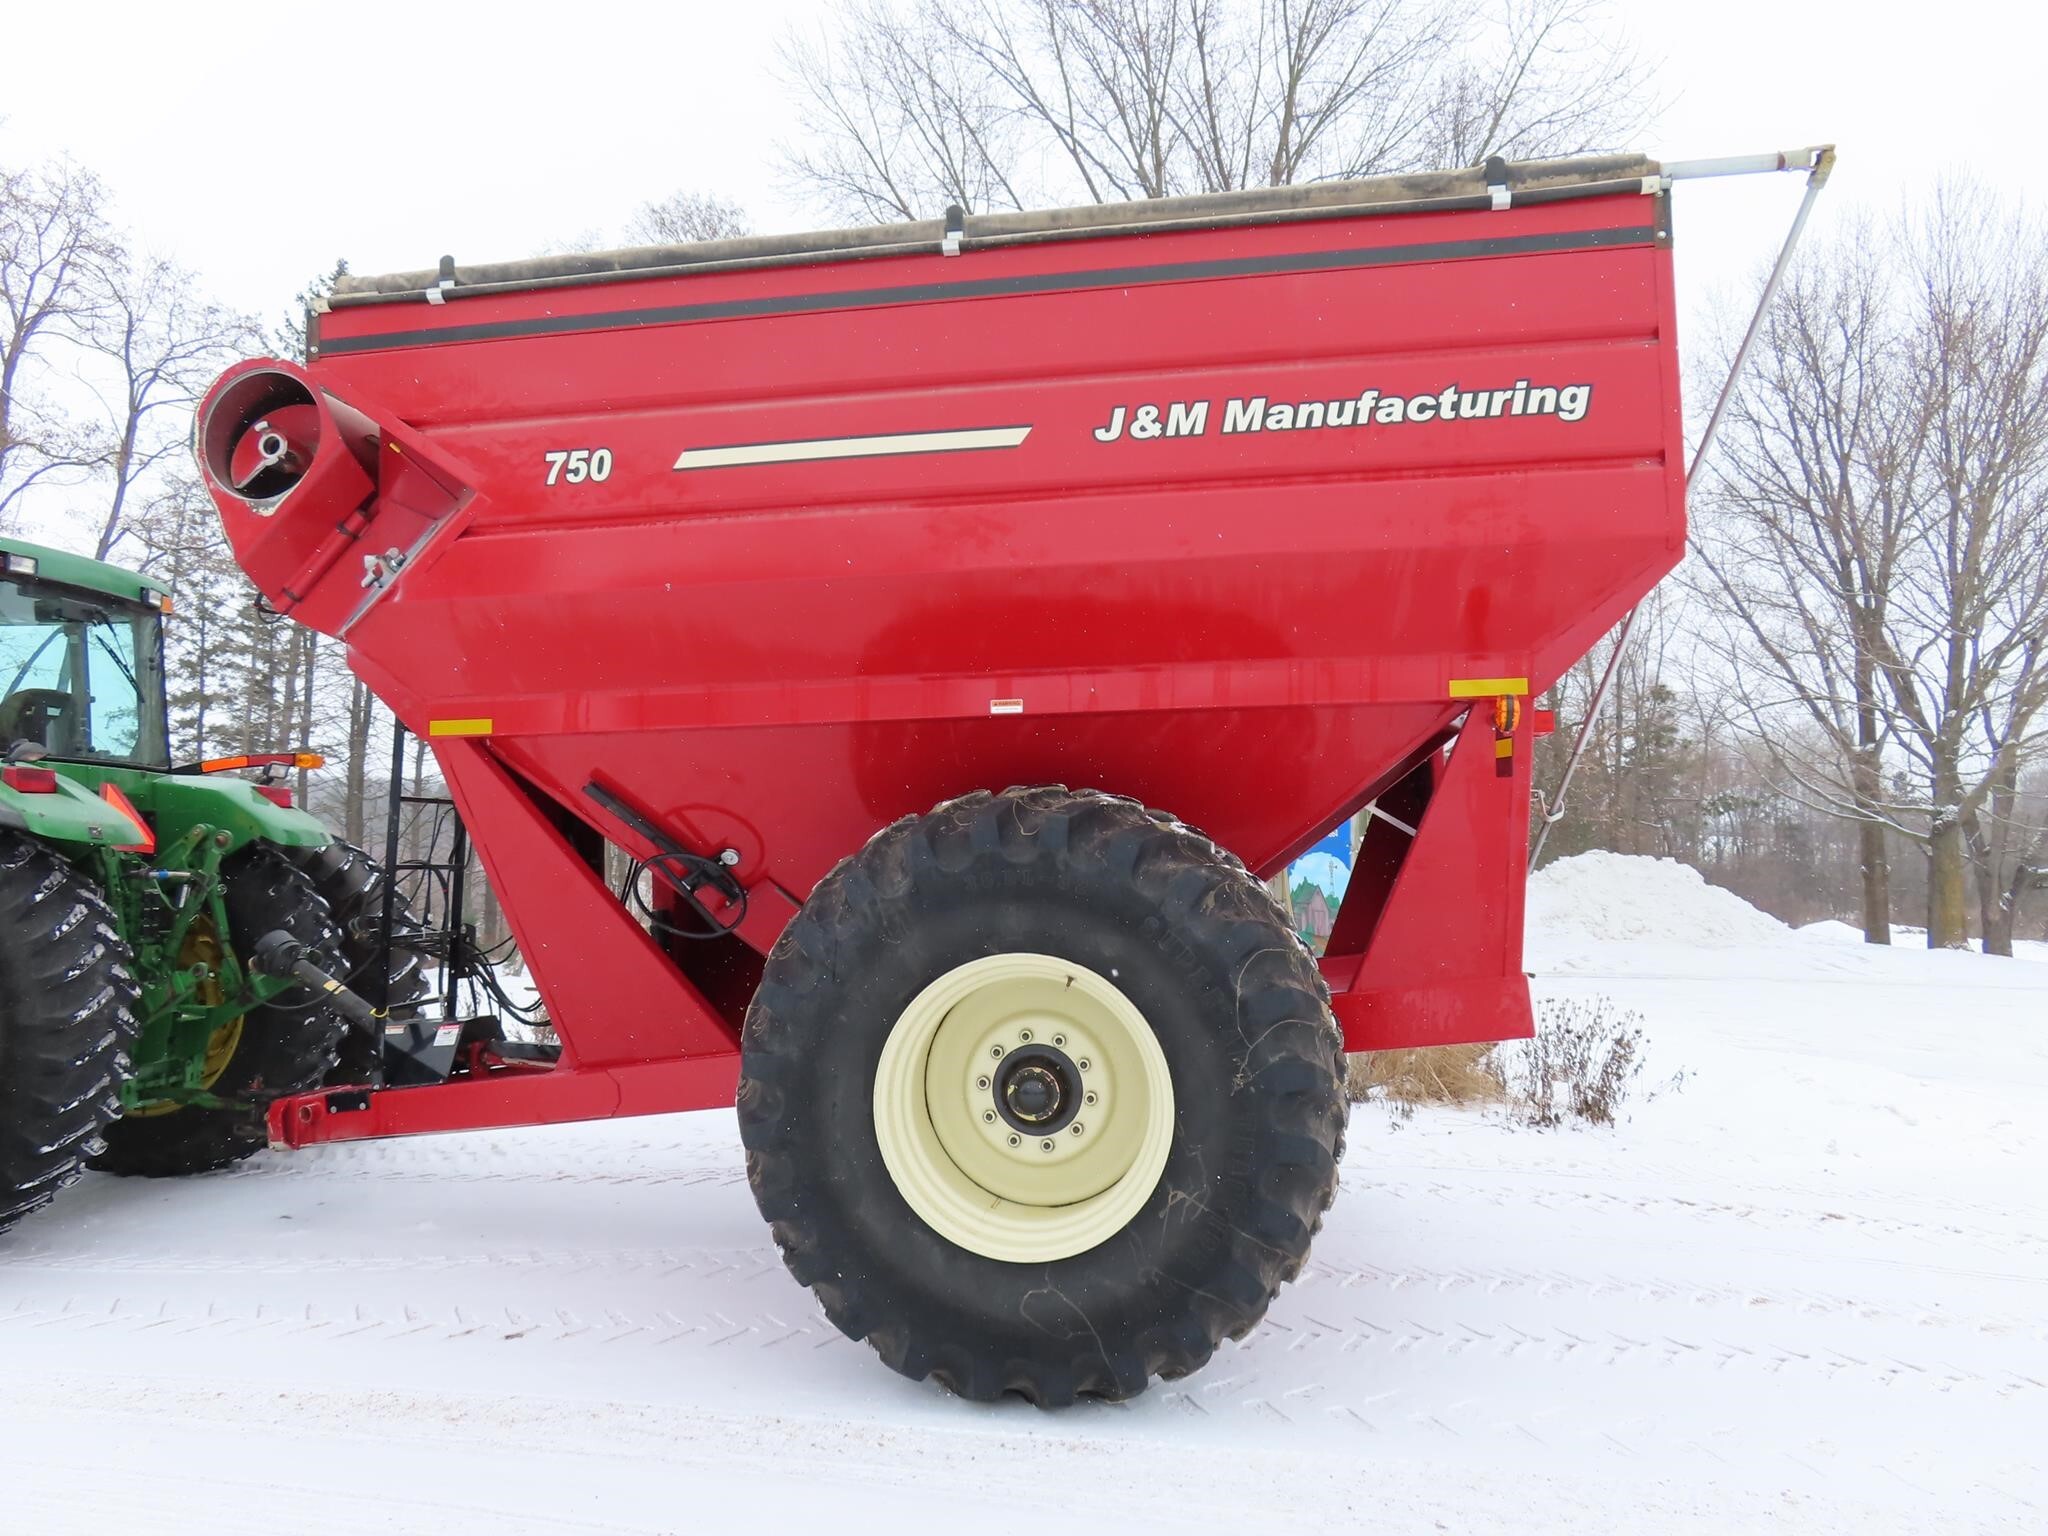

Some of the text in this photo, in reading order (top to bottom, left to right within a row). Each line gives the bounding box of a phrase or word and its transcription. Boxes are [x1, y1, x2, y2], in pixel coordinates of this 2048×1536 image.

[1093, 380, 1591, 441] J&M Manufacturing
[544, 447, 613, 486] 750
